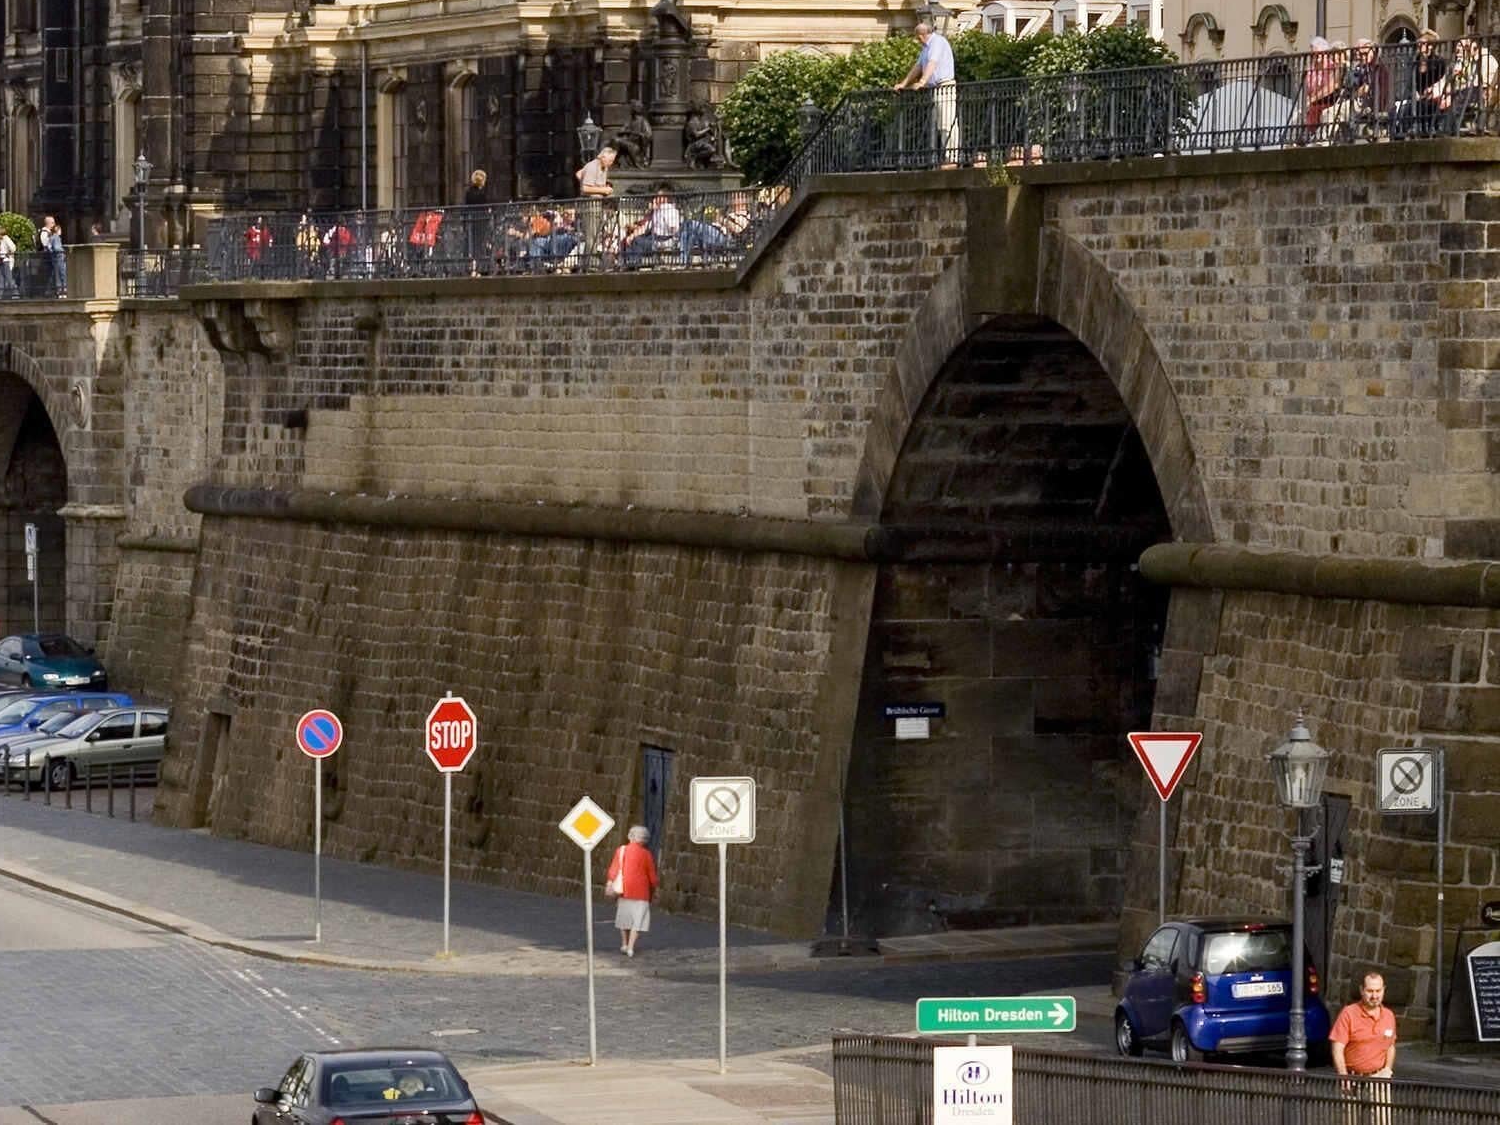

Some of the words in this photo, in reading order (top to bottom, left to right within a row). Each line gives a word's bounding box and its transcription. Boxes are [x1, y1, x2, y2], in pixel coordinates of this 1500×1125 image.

[431, 720, 472, 750] STOP
[1394, 796, 1420, 807] ZONE
[708, 825, 737, 835] ZONE
[937, 1008, 980, 1022] Hilton
[984, 1007, 1043, 1021] Dresden
[943, 1088, 1003, 1105] Hilton
[951, 1106, 996, 1116] Dresden
